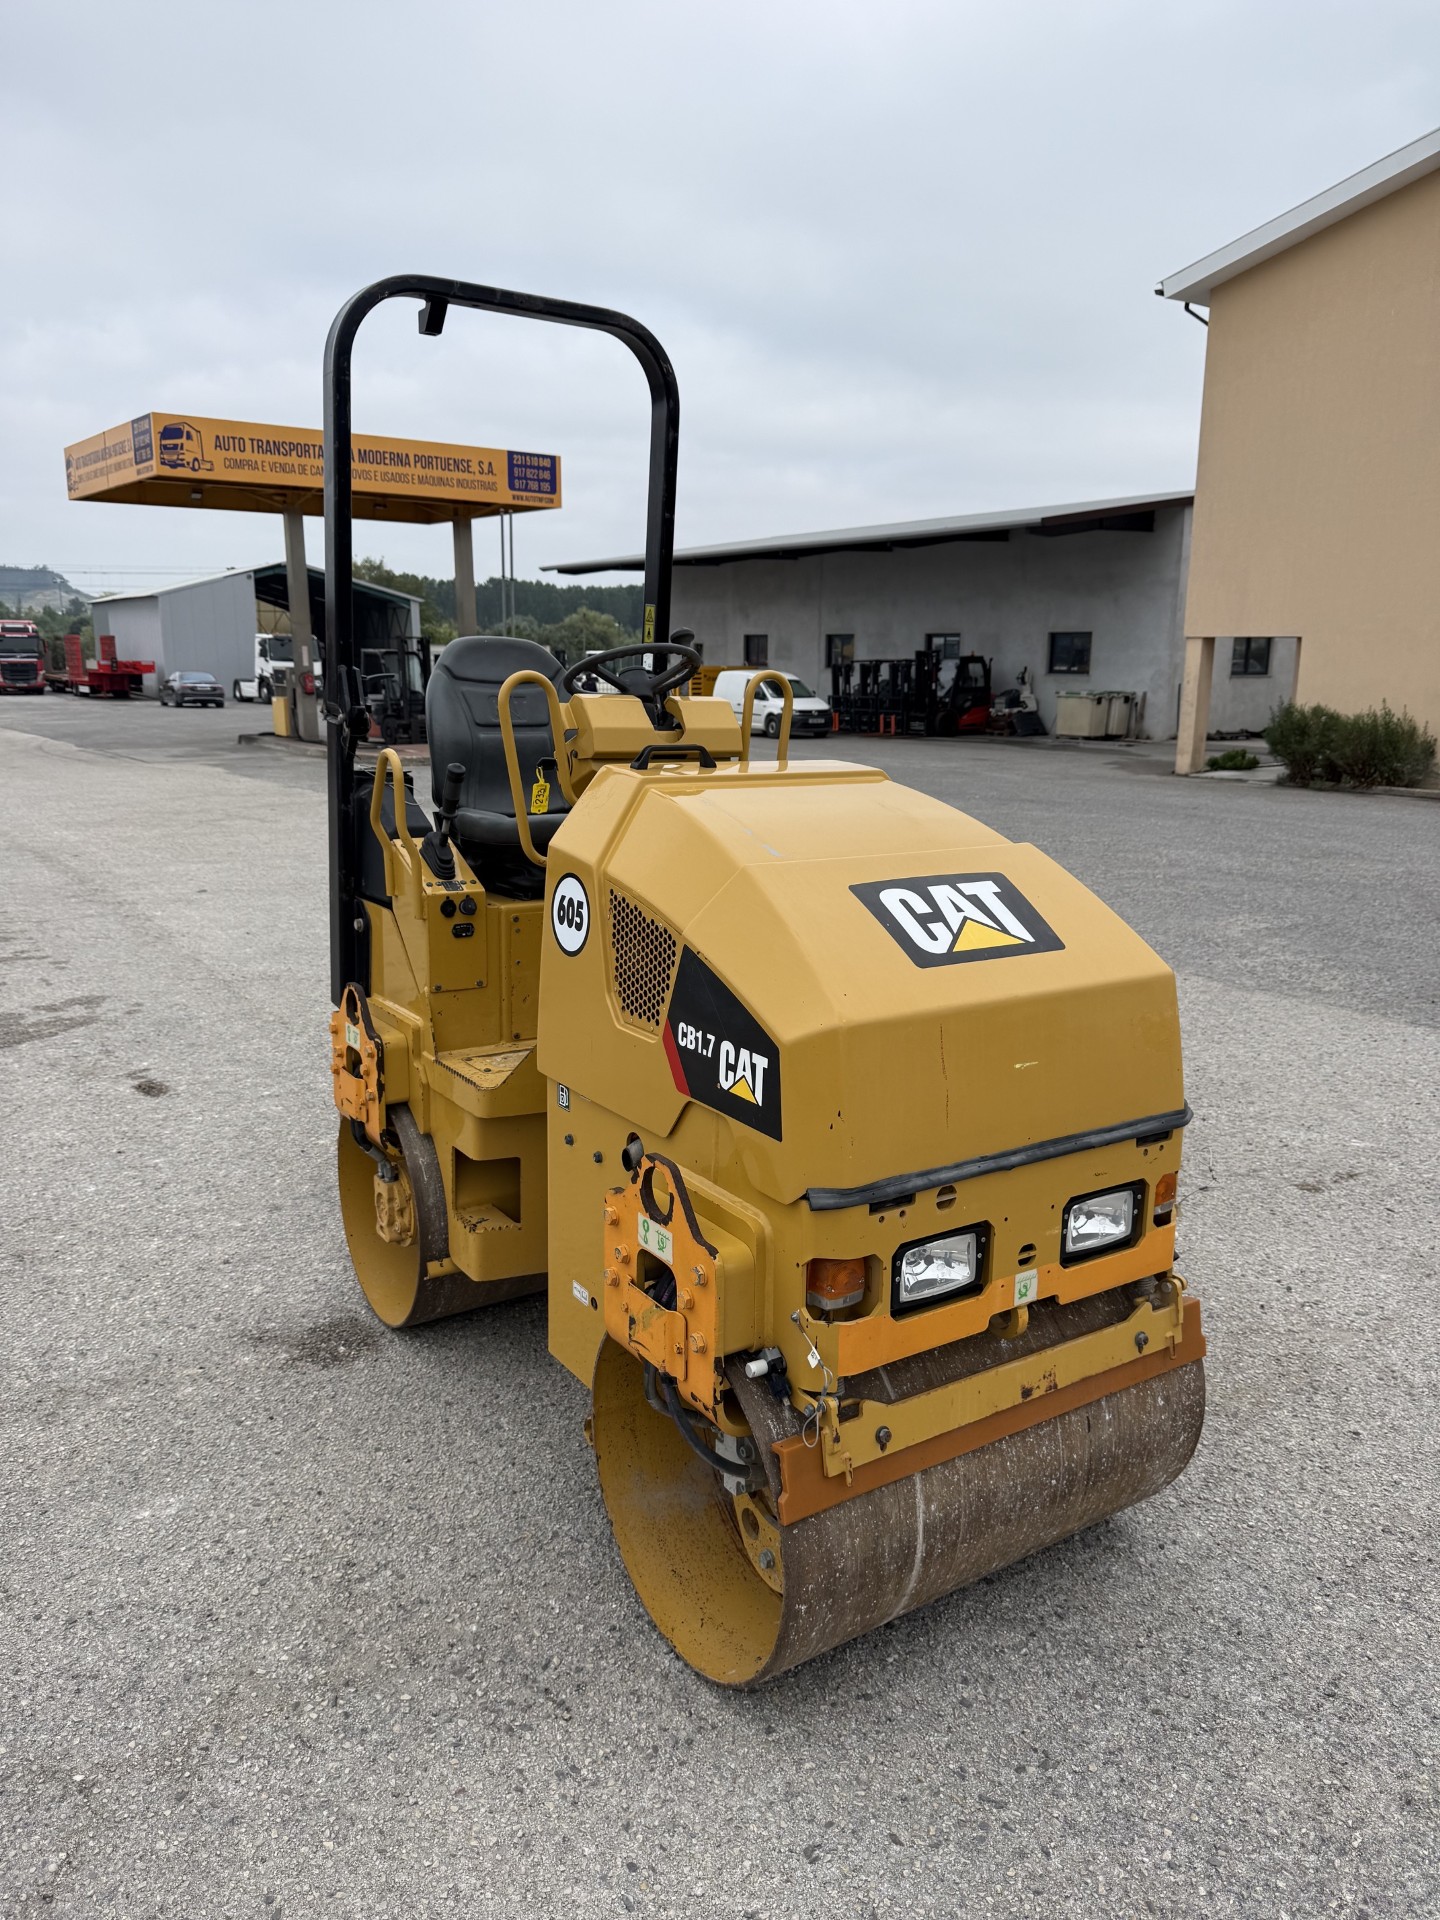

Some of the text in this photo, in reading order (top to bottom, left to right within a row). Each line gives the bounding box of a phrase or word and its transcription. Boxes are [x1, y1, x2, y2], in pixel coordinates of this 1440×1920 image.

[214, 435, 497, 476] AUTO TRANSPORTAA MODERNA PORTUENSE, S.A.
[513, 467, 525, 478] 917
[223, 457, 259, 471] COMPRA
[261, 460, 267, 472] E
[268, 461, 296, 474] VENDA
[298, 463, 308, 475] DE
[352, 468, 373, 481] OVOS
[373, 470, 379, 481] E
[380, 471, 410, 485] USADOS
[411, 473, 416, 485] E
[456, 478, 498, 492] INDUSTRIAIS
[514, 479, 526, 489] 917
[557, 895, 584, 932] 605
[879, 880, 1036, 954] CAT
[678, 1021, 715, 1058] CB1.7
[719, 1040, 769, 1107] CAT
